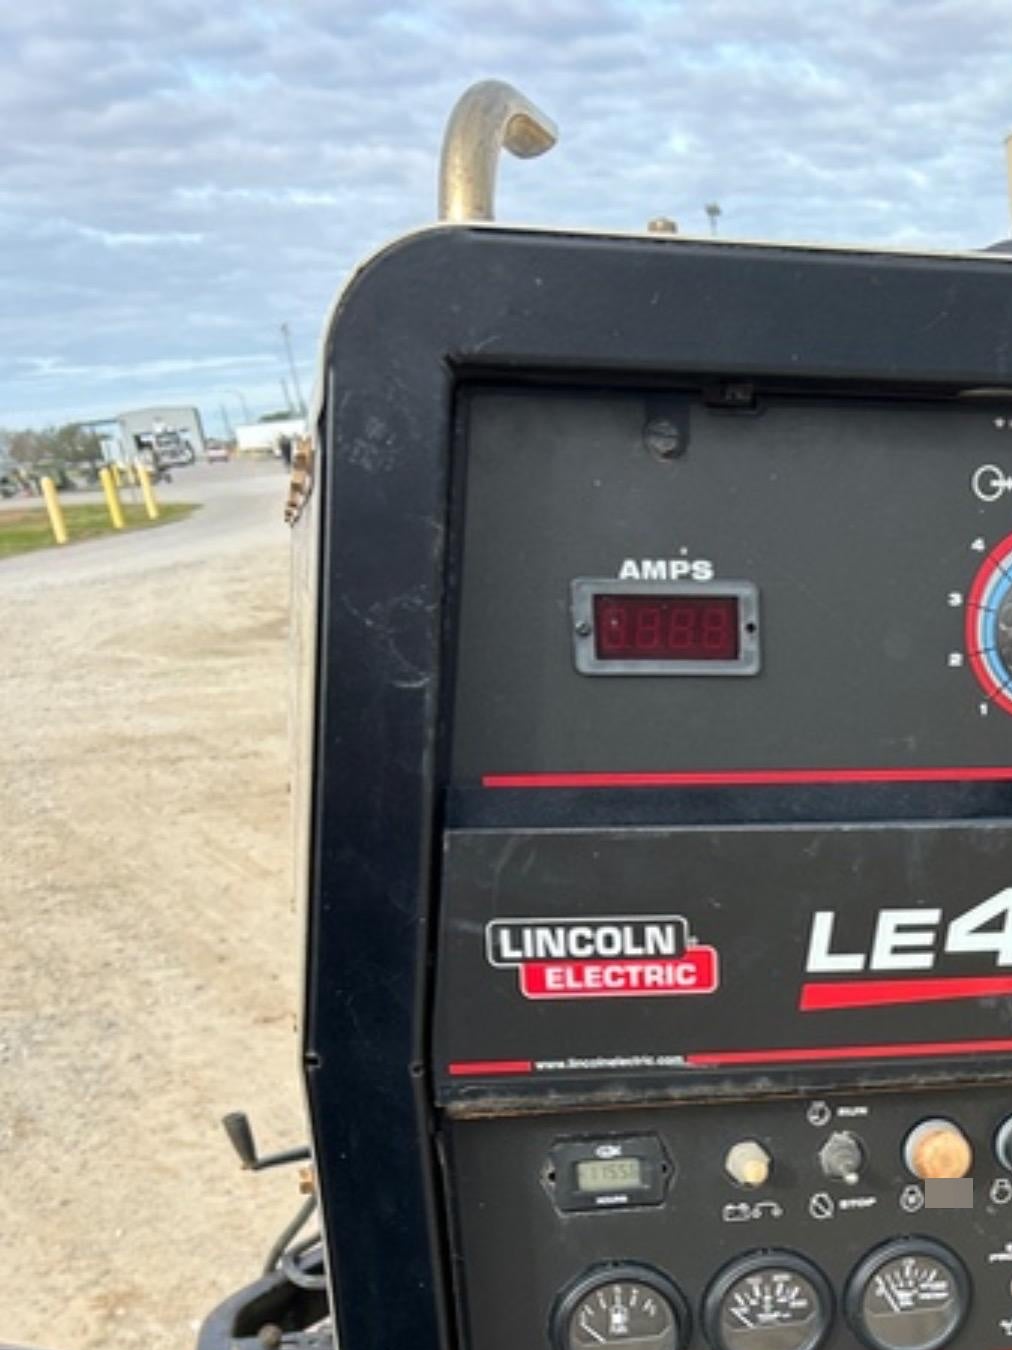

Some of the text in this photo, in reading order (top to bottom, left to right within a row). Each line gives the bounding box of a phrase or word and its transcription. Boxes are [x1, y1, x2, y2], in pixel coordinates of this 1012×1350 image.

[971, 538, 986, 551] 4
[618, 560, 715, 580] AMPS
[980, 703, 988, 716] 1
[499, 926, 676, 958] LINCOLN
[545, 963, 697, 991] ELECTRIC
